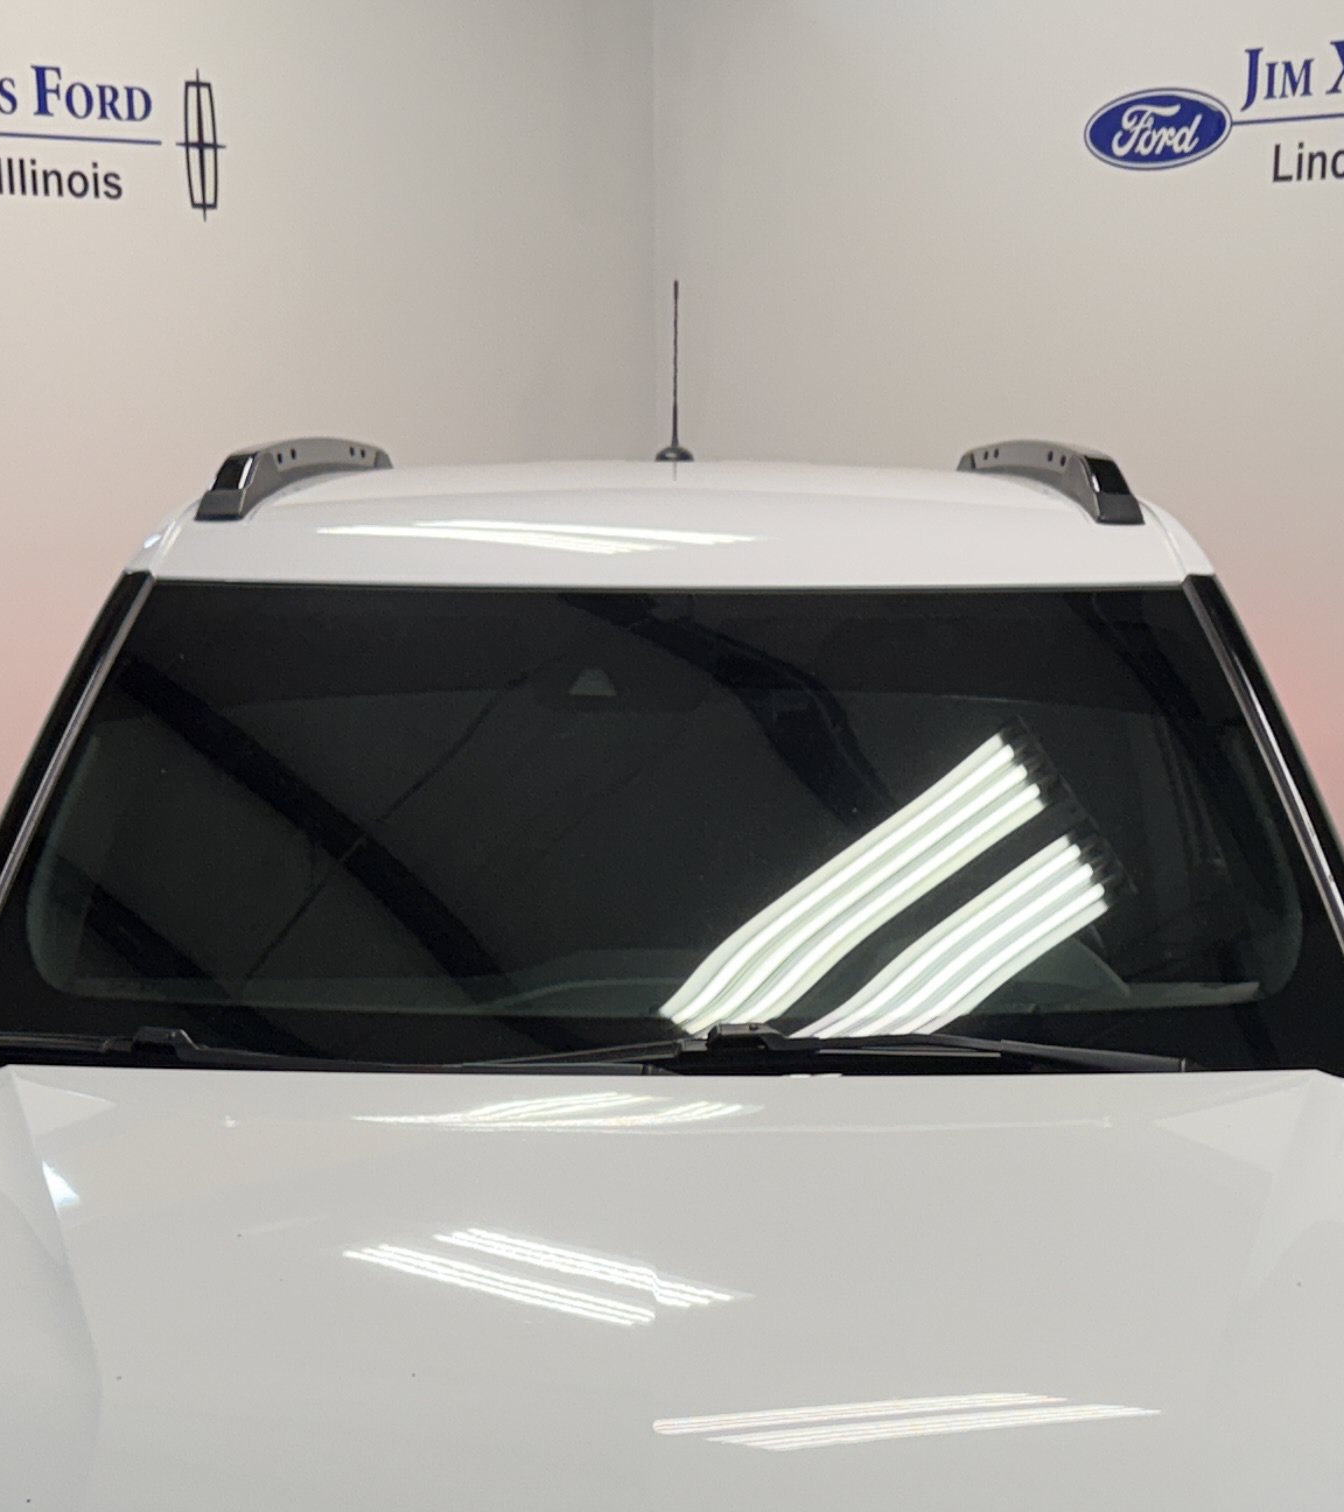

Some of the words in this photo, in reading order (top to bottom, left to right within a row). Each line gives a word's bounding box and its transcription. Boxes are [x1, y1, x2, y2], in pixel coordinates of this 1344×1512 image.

[30, 65, 153, 122] FORD
[1241, 47, 1314, 111] JIM
[1111, 103, 1201, 157] Ford
